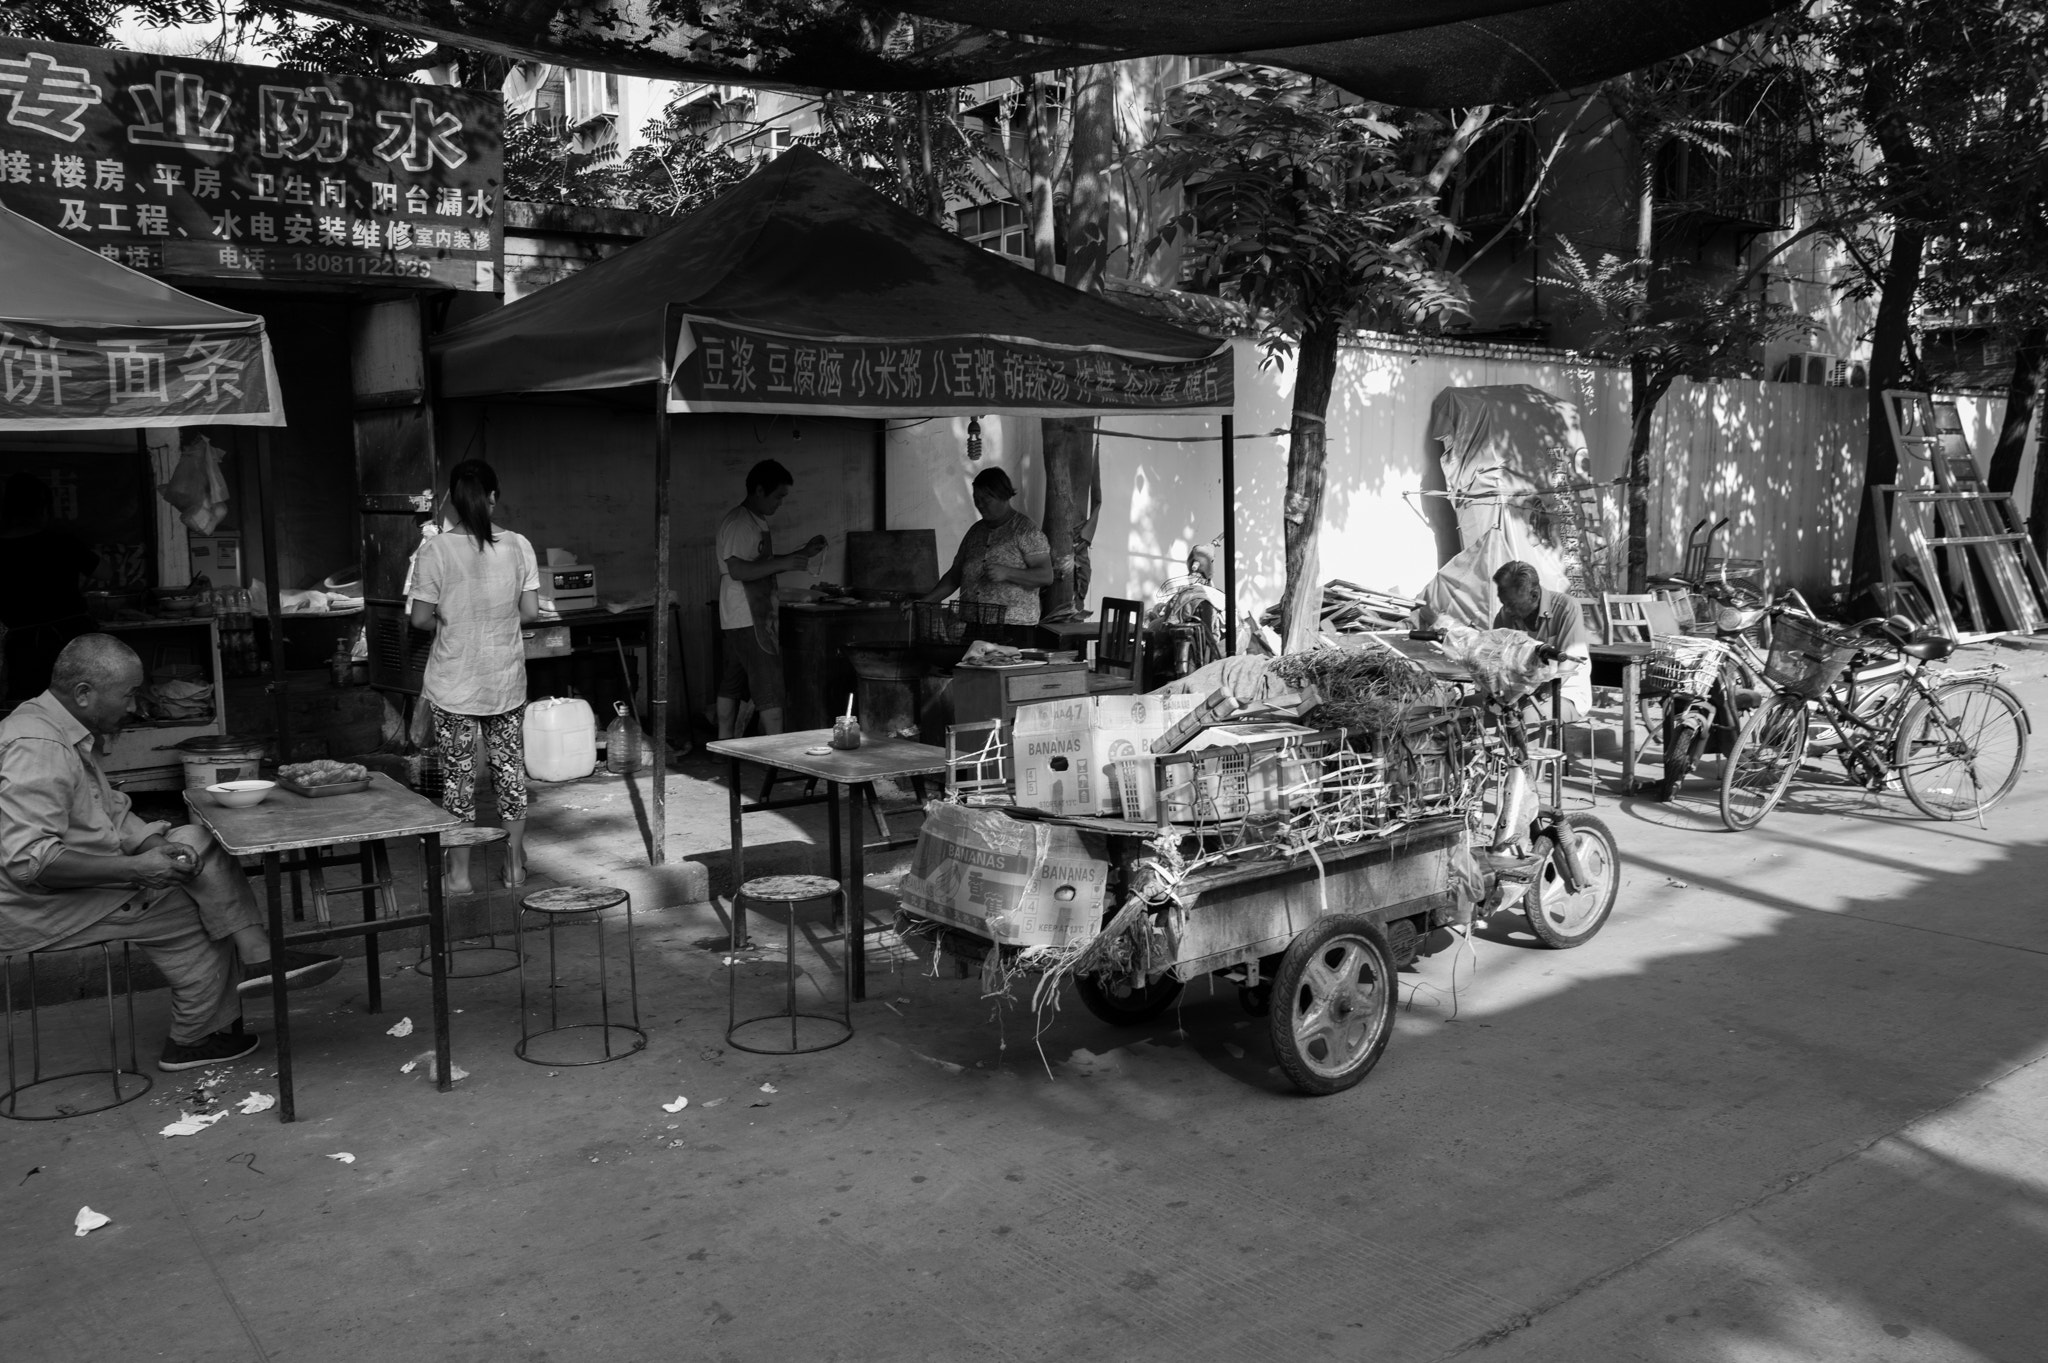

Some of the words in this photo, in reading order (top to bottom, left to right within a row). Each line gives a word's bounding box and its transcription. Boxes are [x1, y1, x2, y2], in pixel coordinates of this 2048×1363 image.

[0, 52, 467, 172] 专业防水
[1028, 738, 1081, 756] BANANAS
[949, 844, 1005, 869] BANANAS
[1041, 864, 1096, 882] BANANAS
